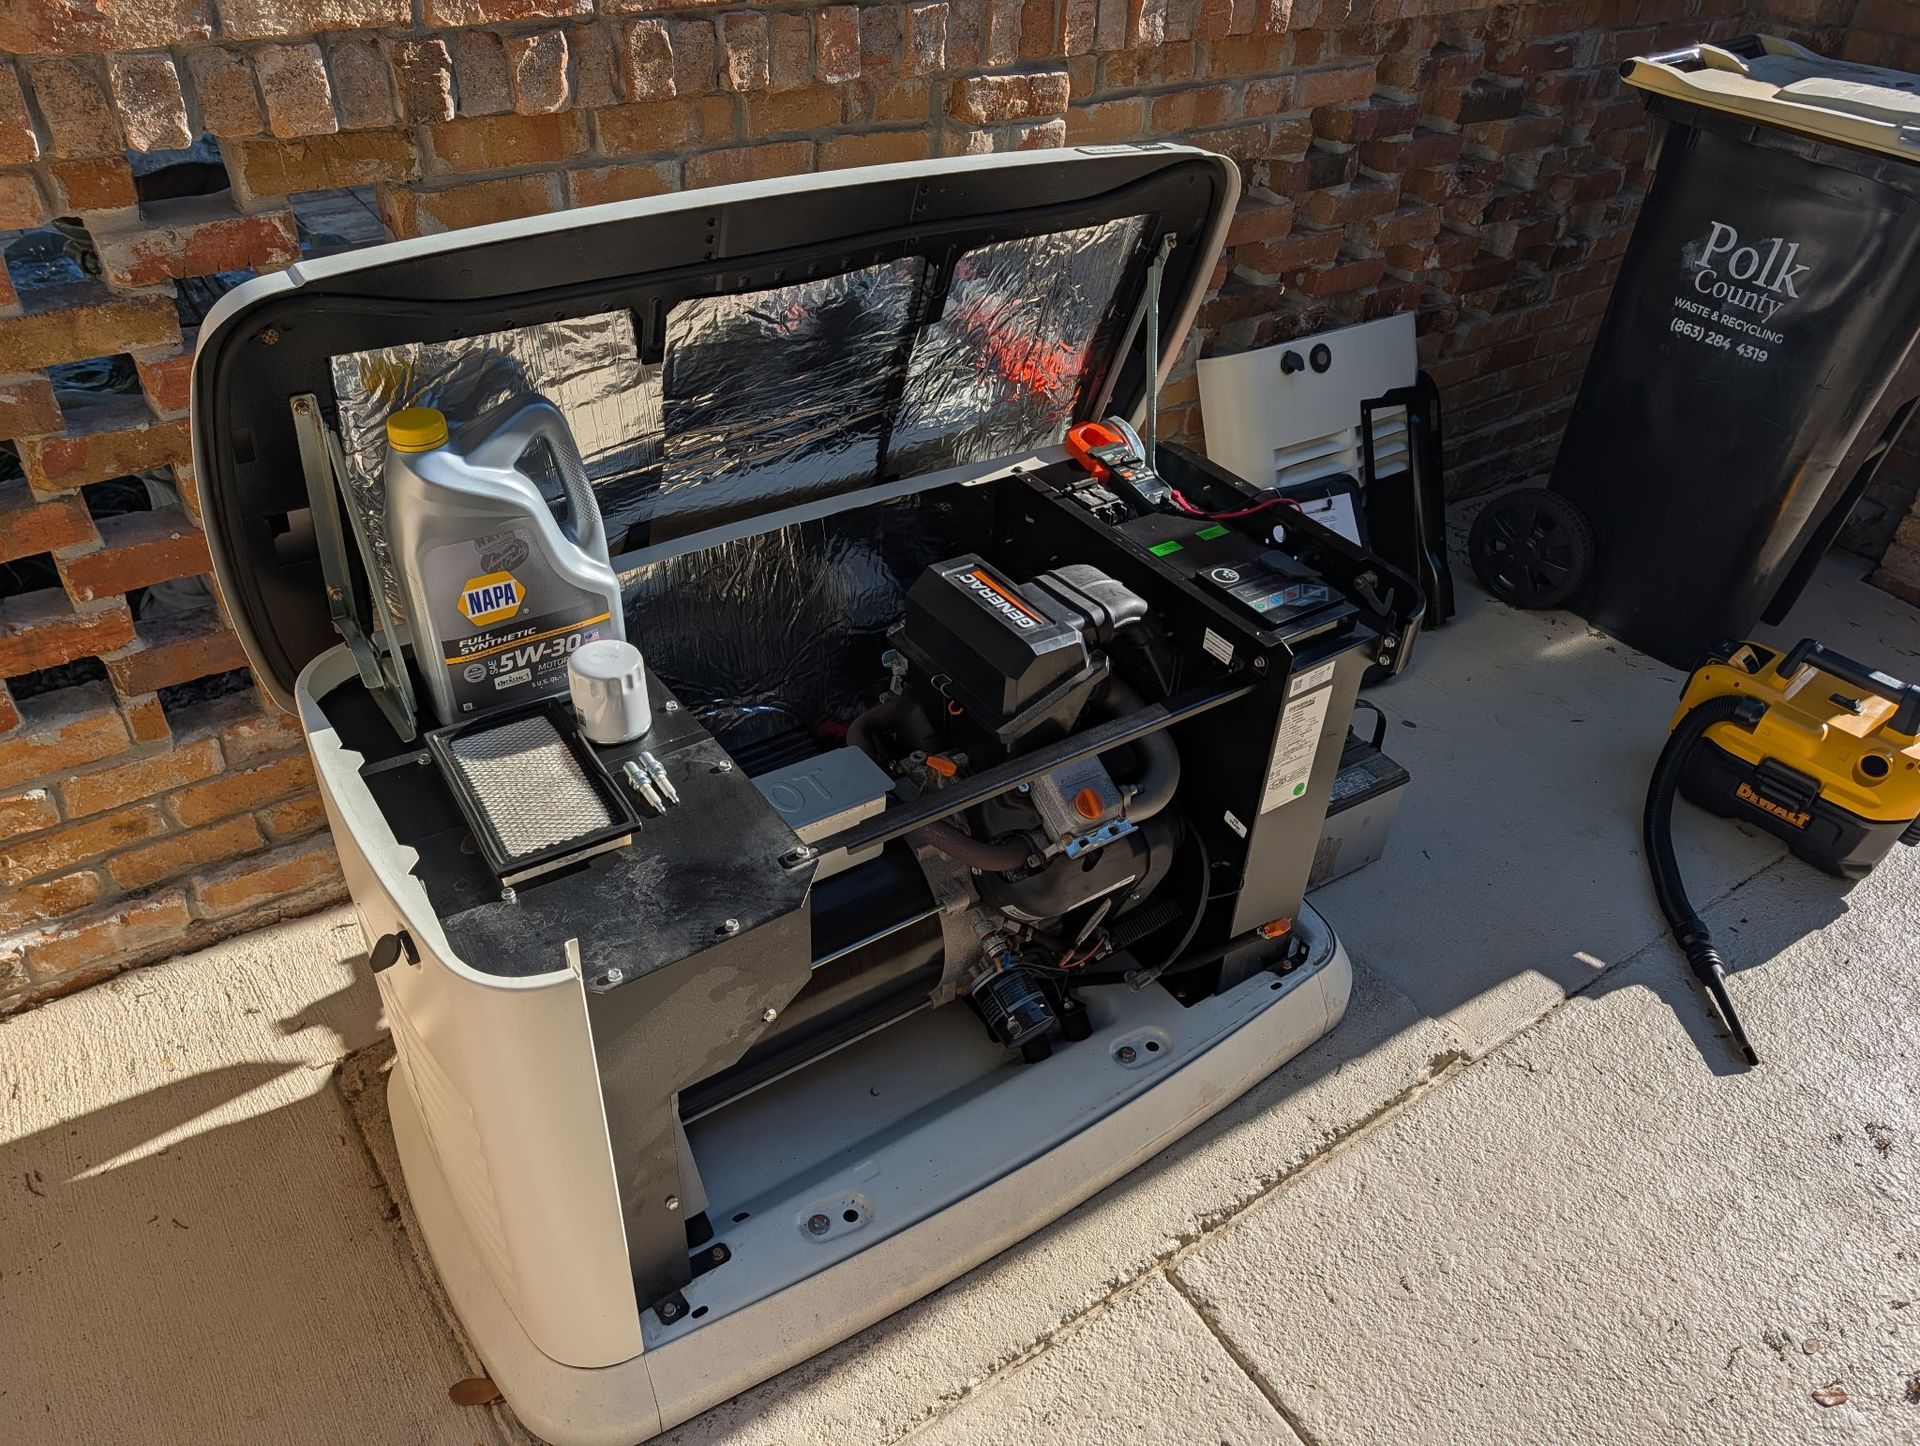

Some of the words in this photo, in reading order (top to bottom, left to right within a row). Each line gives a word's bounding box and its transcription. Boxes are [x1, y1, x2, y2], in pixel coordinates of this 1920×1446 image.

[1694, 220, 1810, 299] Polk
[1694, 269, 1784, 323] County
[1670, 317, 1705, 342] (863)
[1705, 331, 1731, 351] 284
[1735, 343, 1768, 363] 4319
[1674, 296, 1711, 319] WASTE
[1711, 311, 1719, 321] &
[1719, 313, 1784, 345] RECYCLING
[468, 583, 516, 614] NAPA
[959, 573, 1036, 628] GENERAC
[459, 633, 493, 648] FULL
[460, 627, 536, 655] SYNTHETIC
[489, 660, 498, 675] SAE
[500, 633, 581, 673] 5W-30
[769, 767, 833, 813] OT
[1736, 783, 1811, 827] DEWALT
